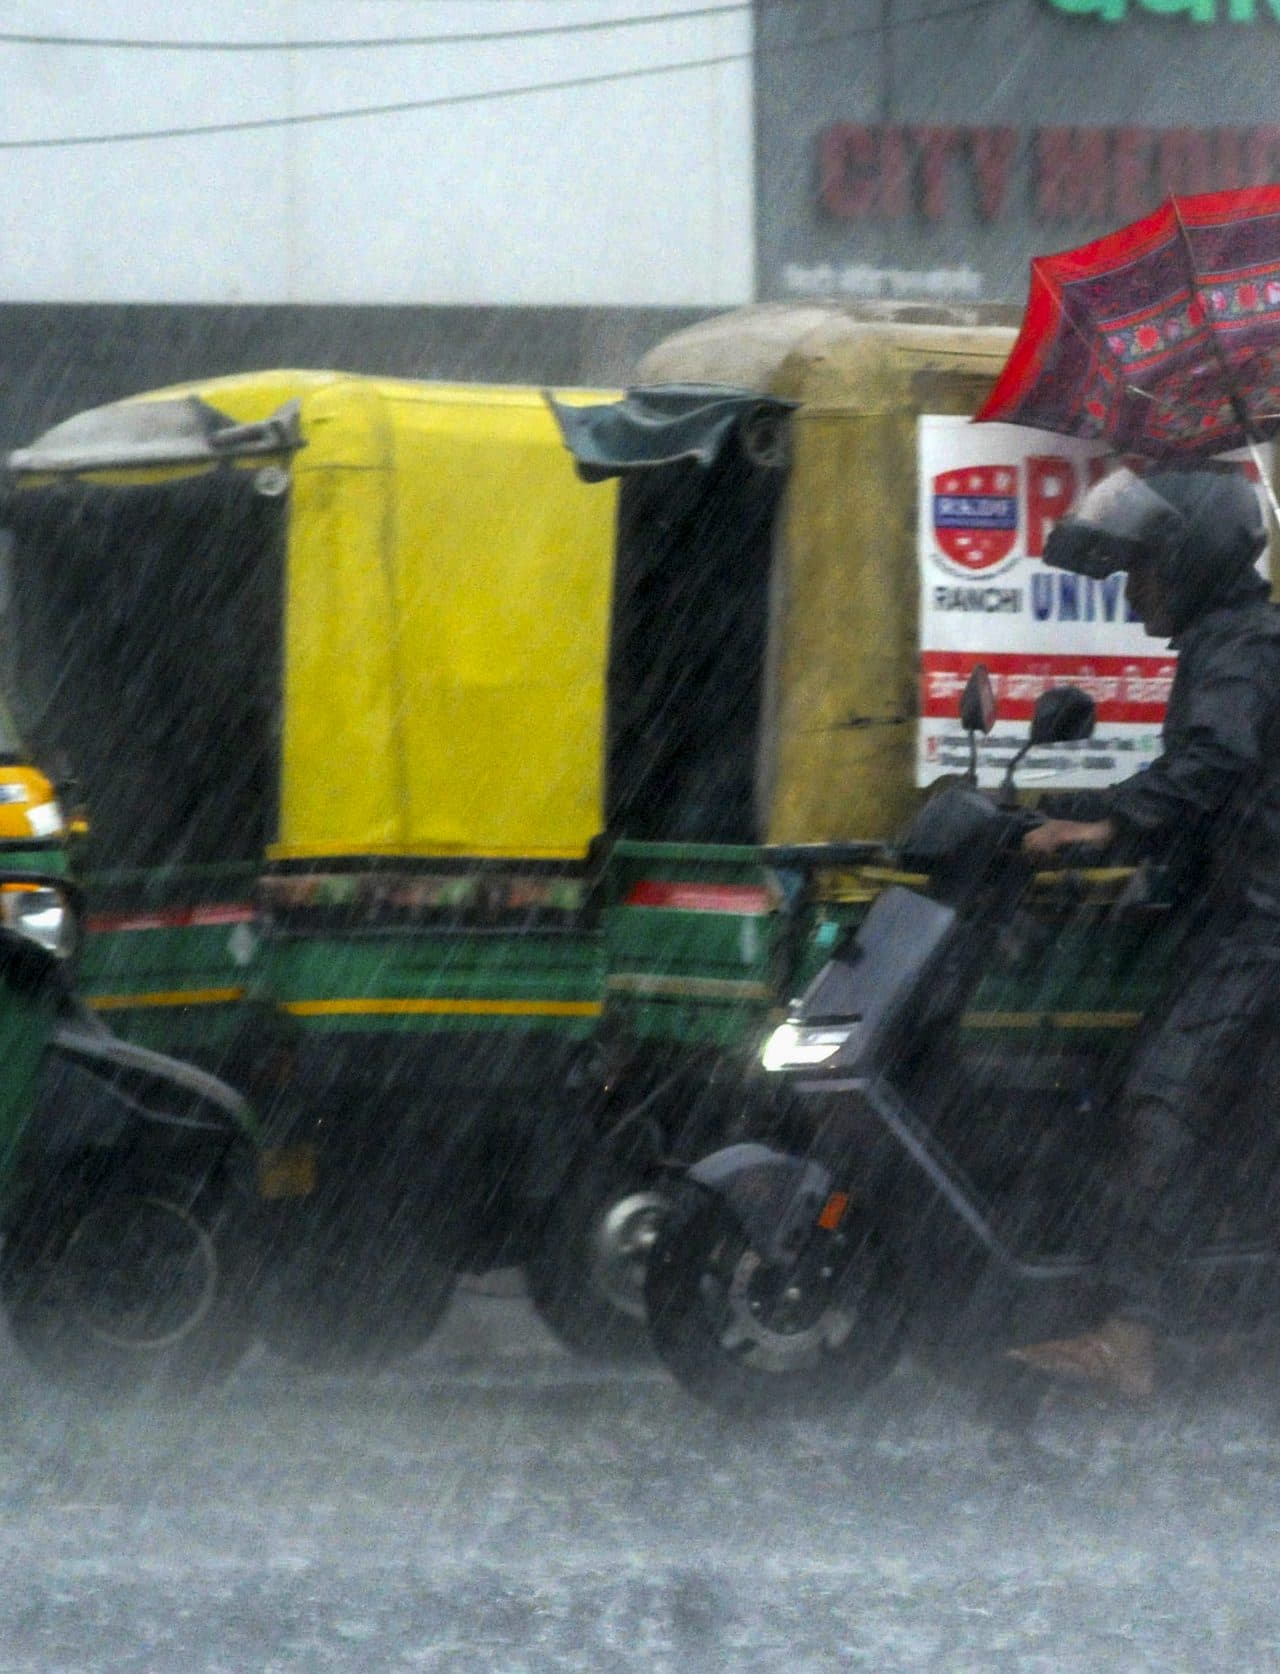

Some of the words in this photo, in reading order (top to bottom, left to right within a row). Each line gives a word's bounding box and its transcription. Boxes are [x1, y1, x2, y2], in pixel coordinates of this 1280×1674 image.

[818, 121, 1018, 219] CITY
[934, 586, 1023, 613] RANCHI
[1031, 572, 1143, 622] UNIV
